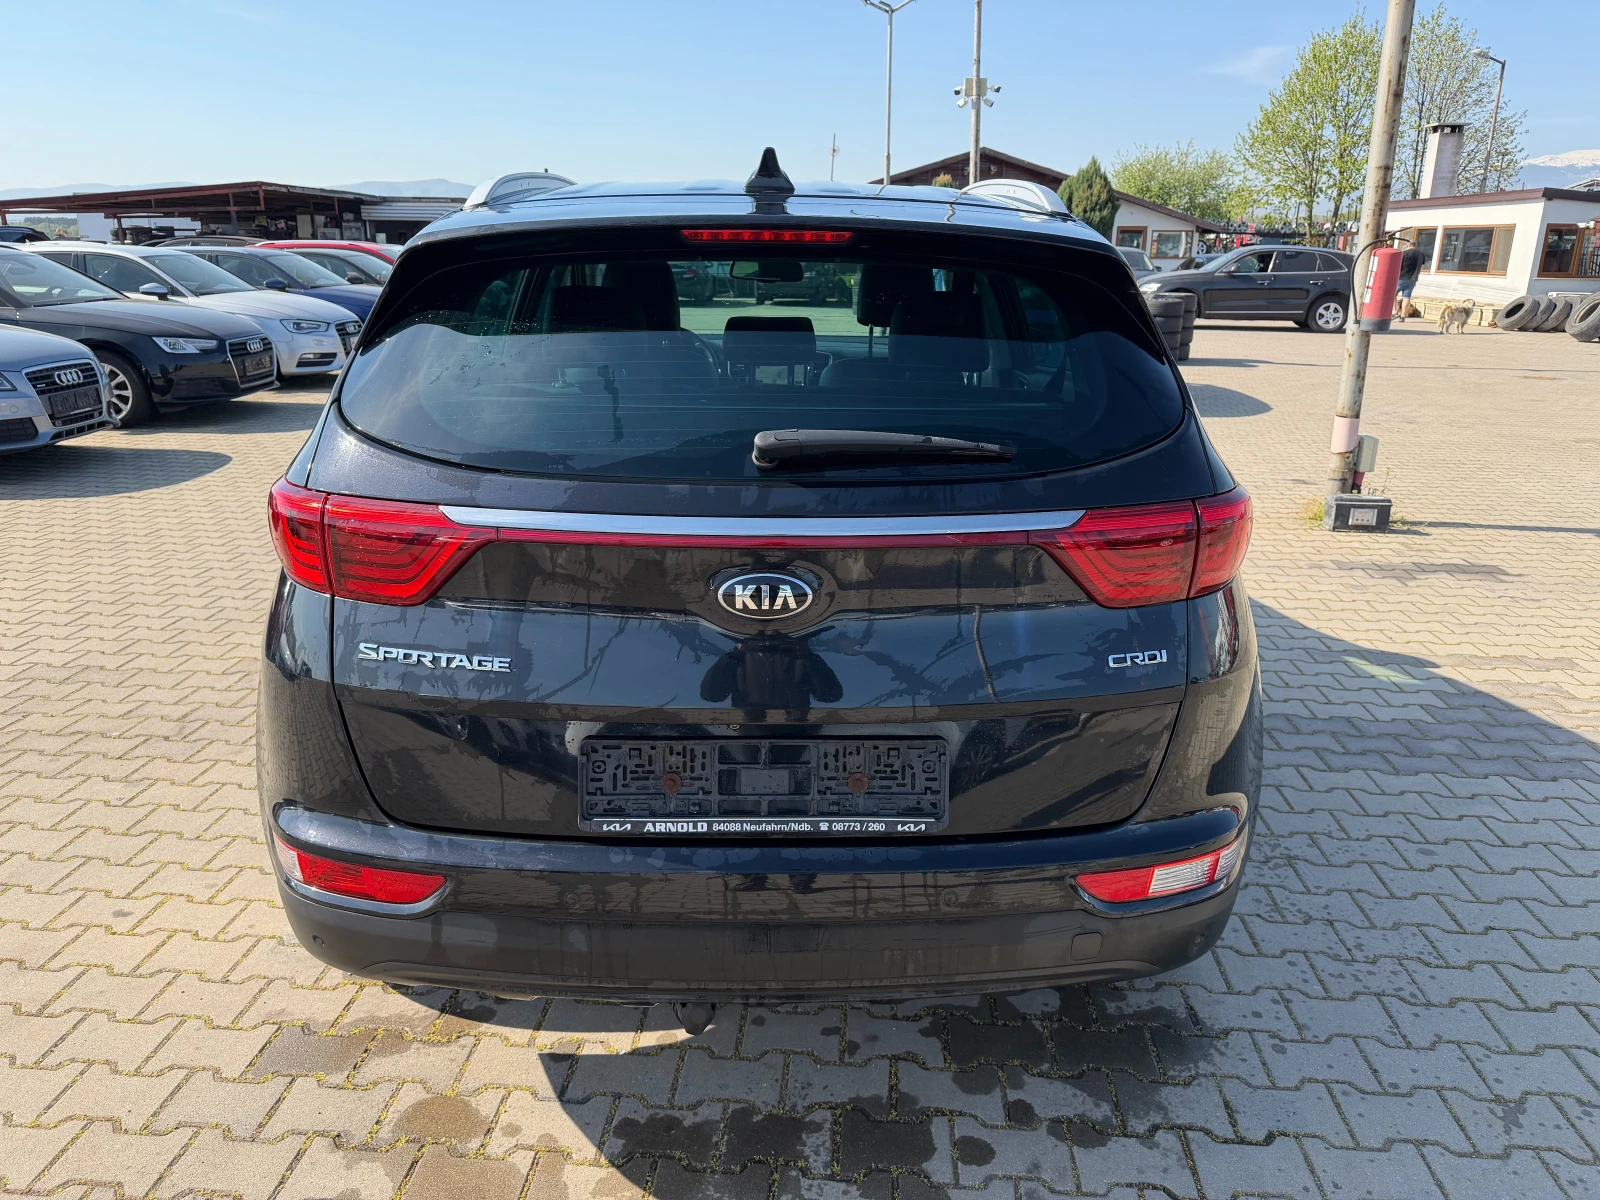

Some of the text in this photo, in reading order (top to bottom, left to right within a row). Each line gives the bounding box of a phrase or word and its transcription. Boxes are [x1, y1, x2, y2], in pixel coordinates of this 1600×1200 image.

[734, 584, 798, 610] KIA
[357, 642, 512, 673] SPORTAGE
[643, 822, 708, 833] ARNOLD
[712, 823, 742, 832] 84088
[743, 822, 814, 832] Neufahrn/Ndb.
[832, 822, 861, 831] 08773
[867, 822, 886, 831] 260
